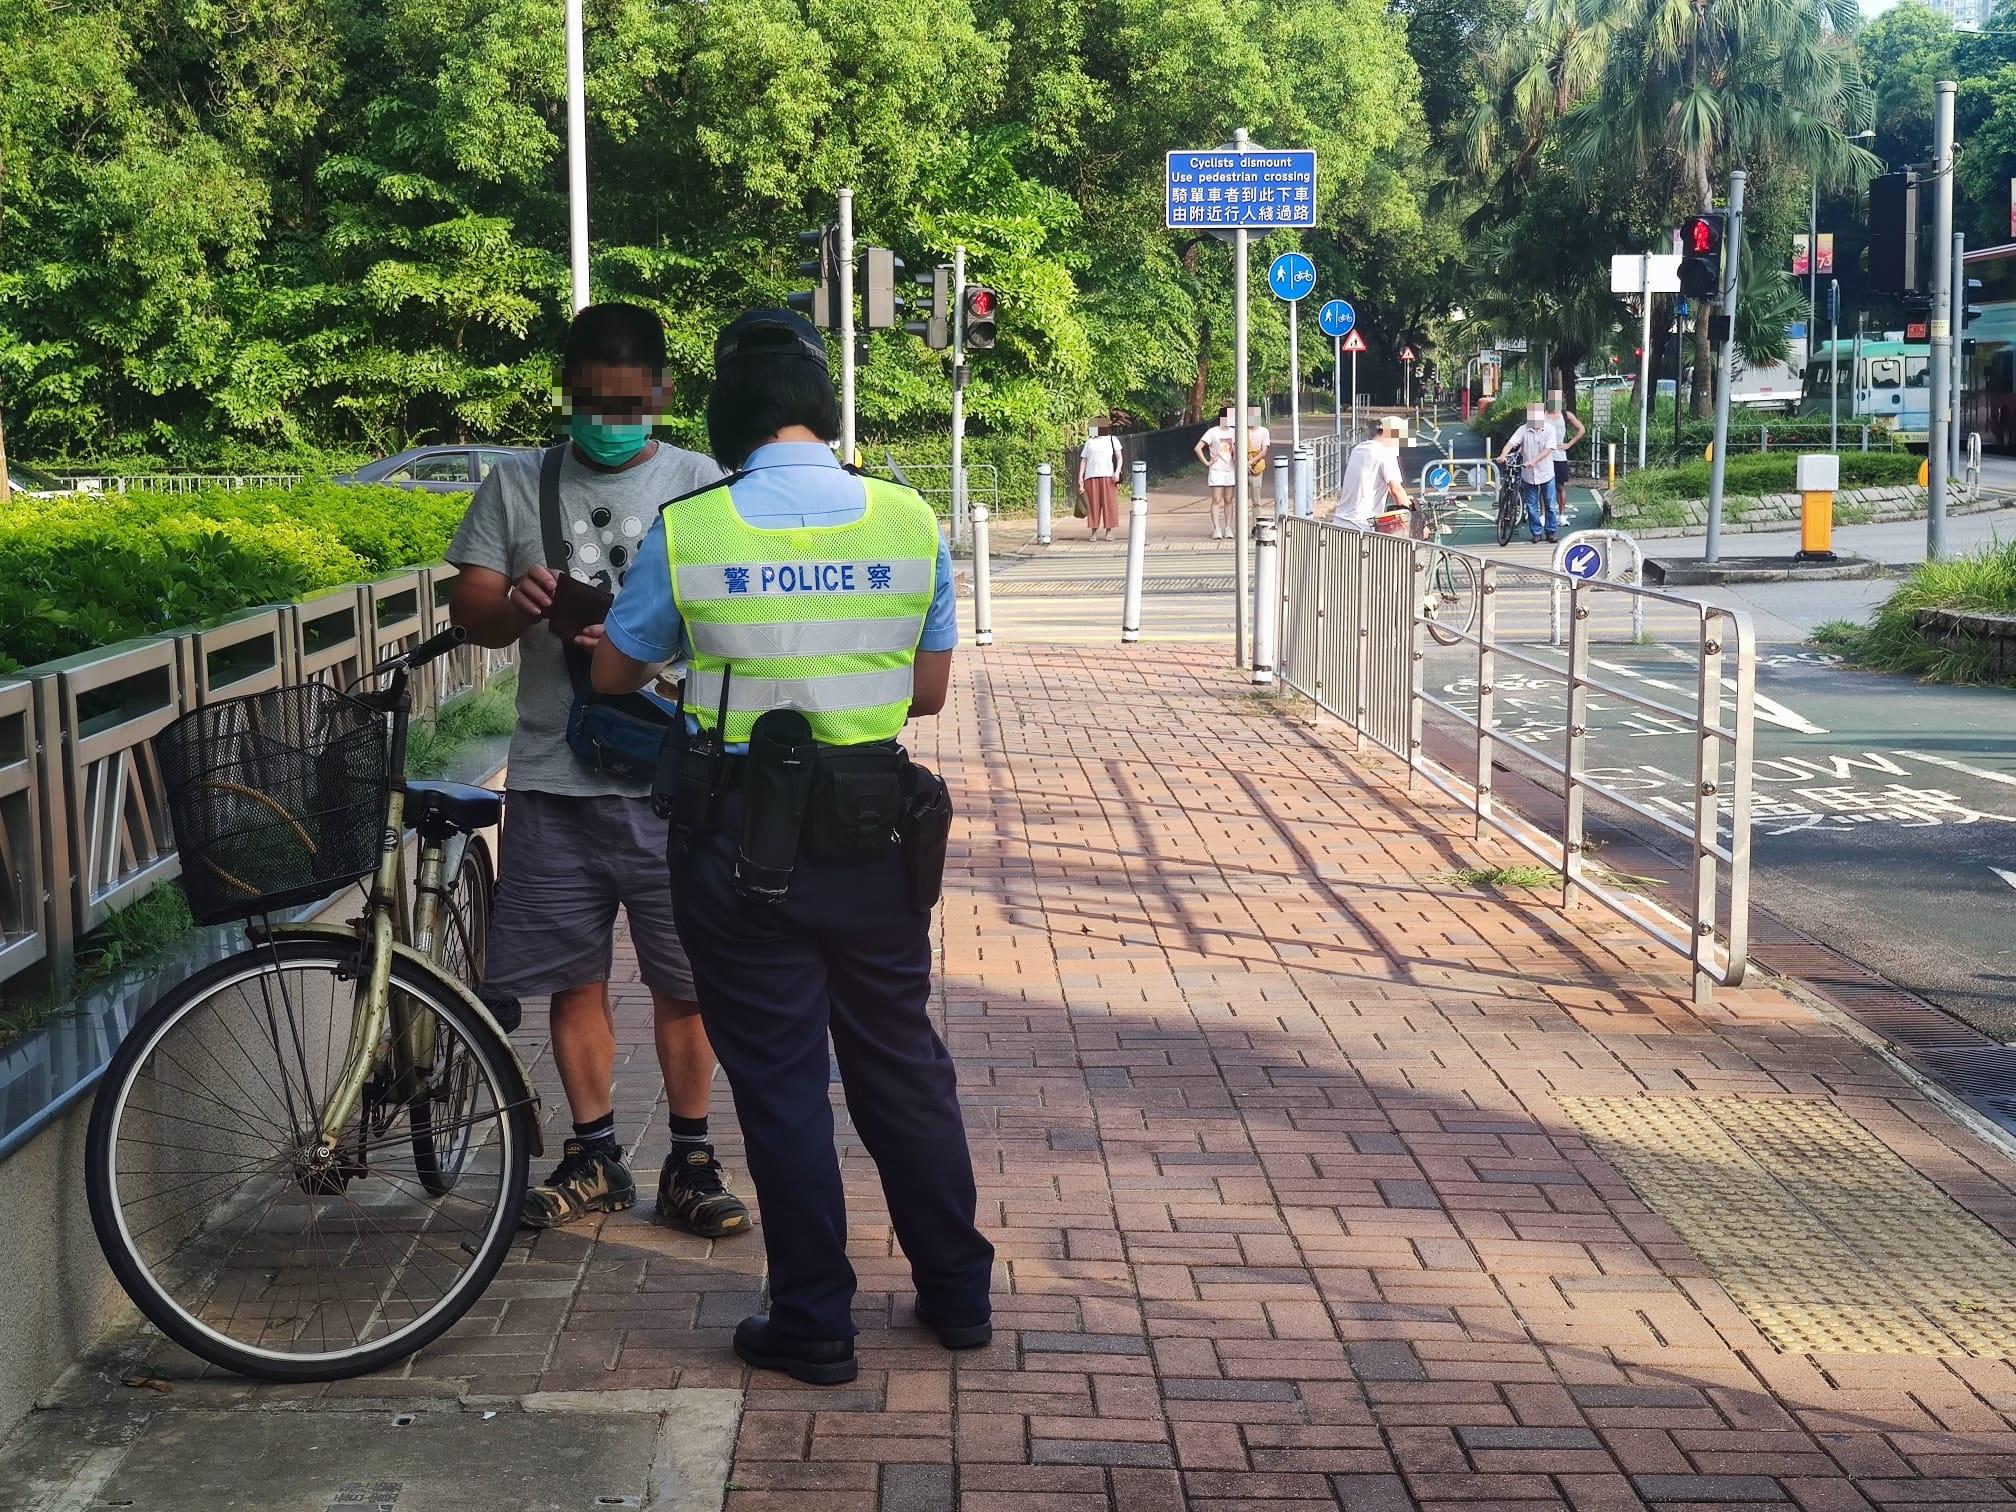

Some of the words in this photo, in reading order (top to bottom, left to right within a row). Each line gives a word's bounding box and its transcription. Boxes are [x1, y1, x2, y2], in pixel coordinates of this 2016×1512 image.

[1190, 157, 1234, 170] Cyclists
[1240, 157, 1292, 168] dismount
[1171, 172, 1193, 183] Use
[1199, 172, 1258, 184] pedestrian
[1264, 171, 1310, 183] crossing
[1172, 187, 1309, 203] 騎單車者到此下車
[1173, 205, 1309, 222] 由附近行人綫過路
[724, 567, 750, 594] 警
[762, 565, 855, 592] POLICE
[867, 563, 892, 590] 察
[1583, 752, 1912, 790] SLOW
